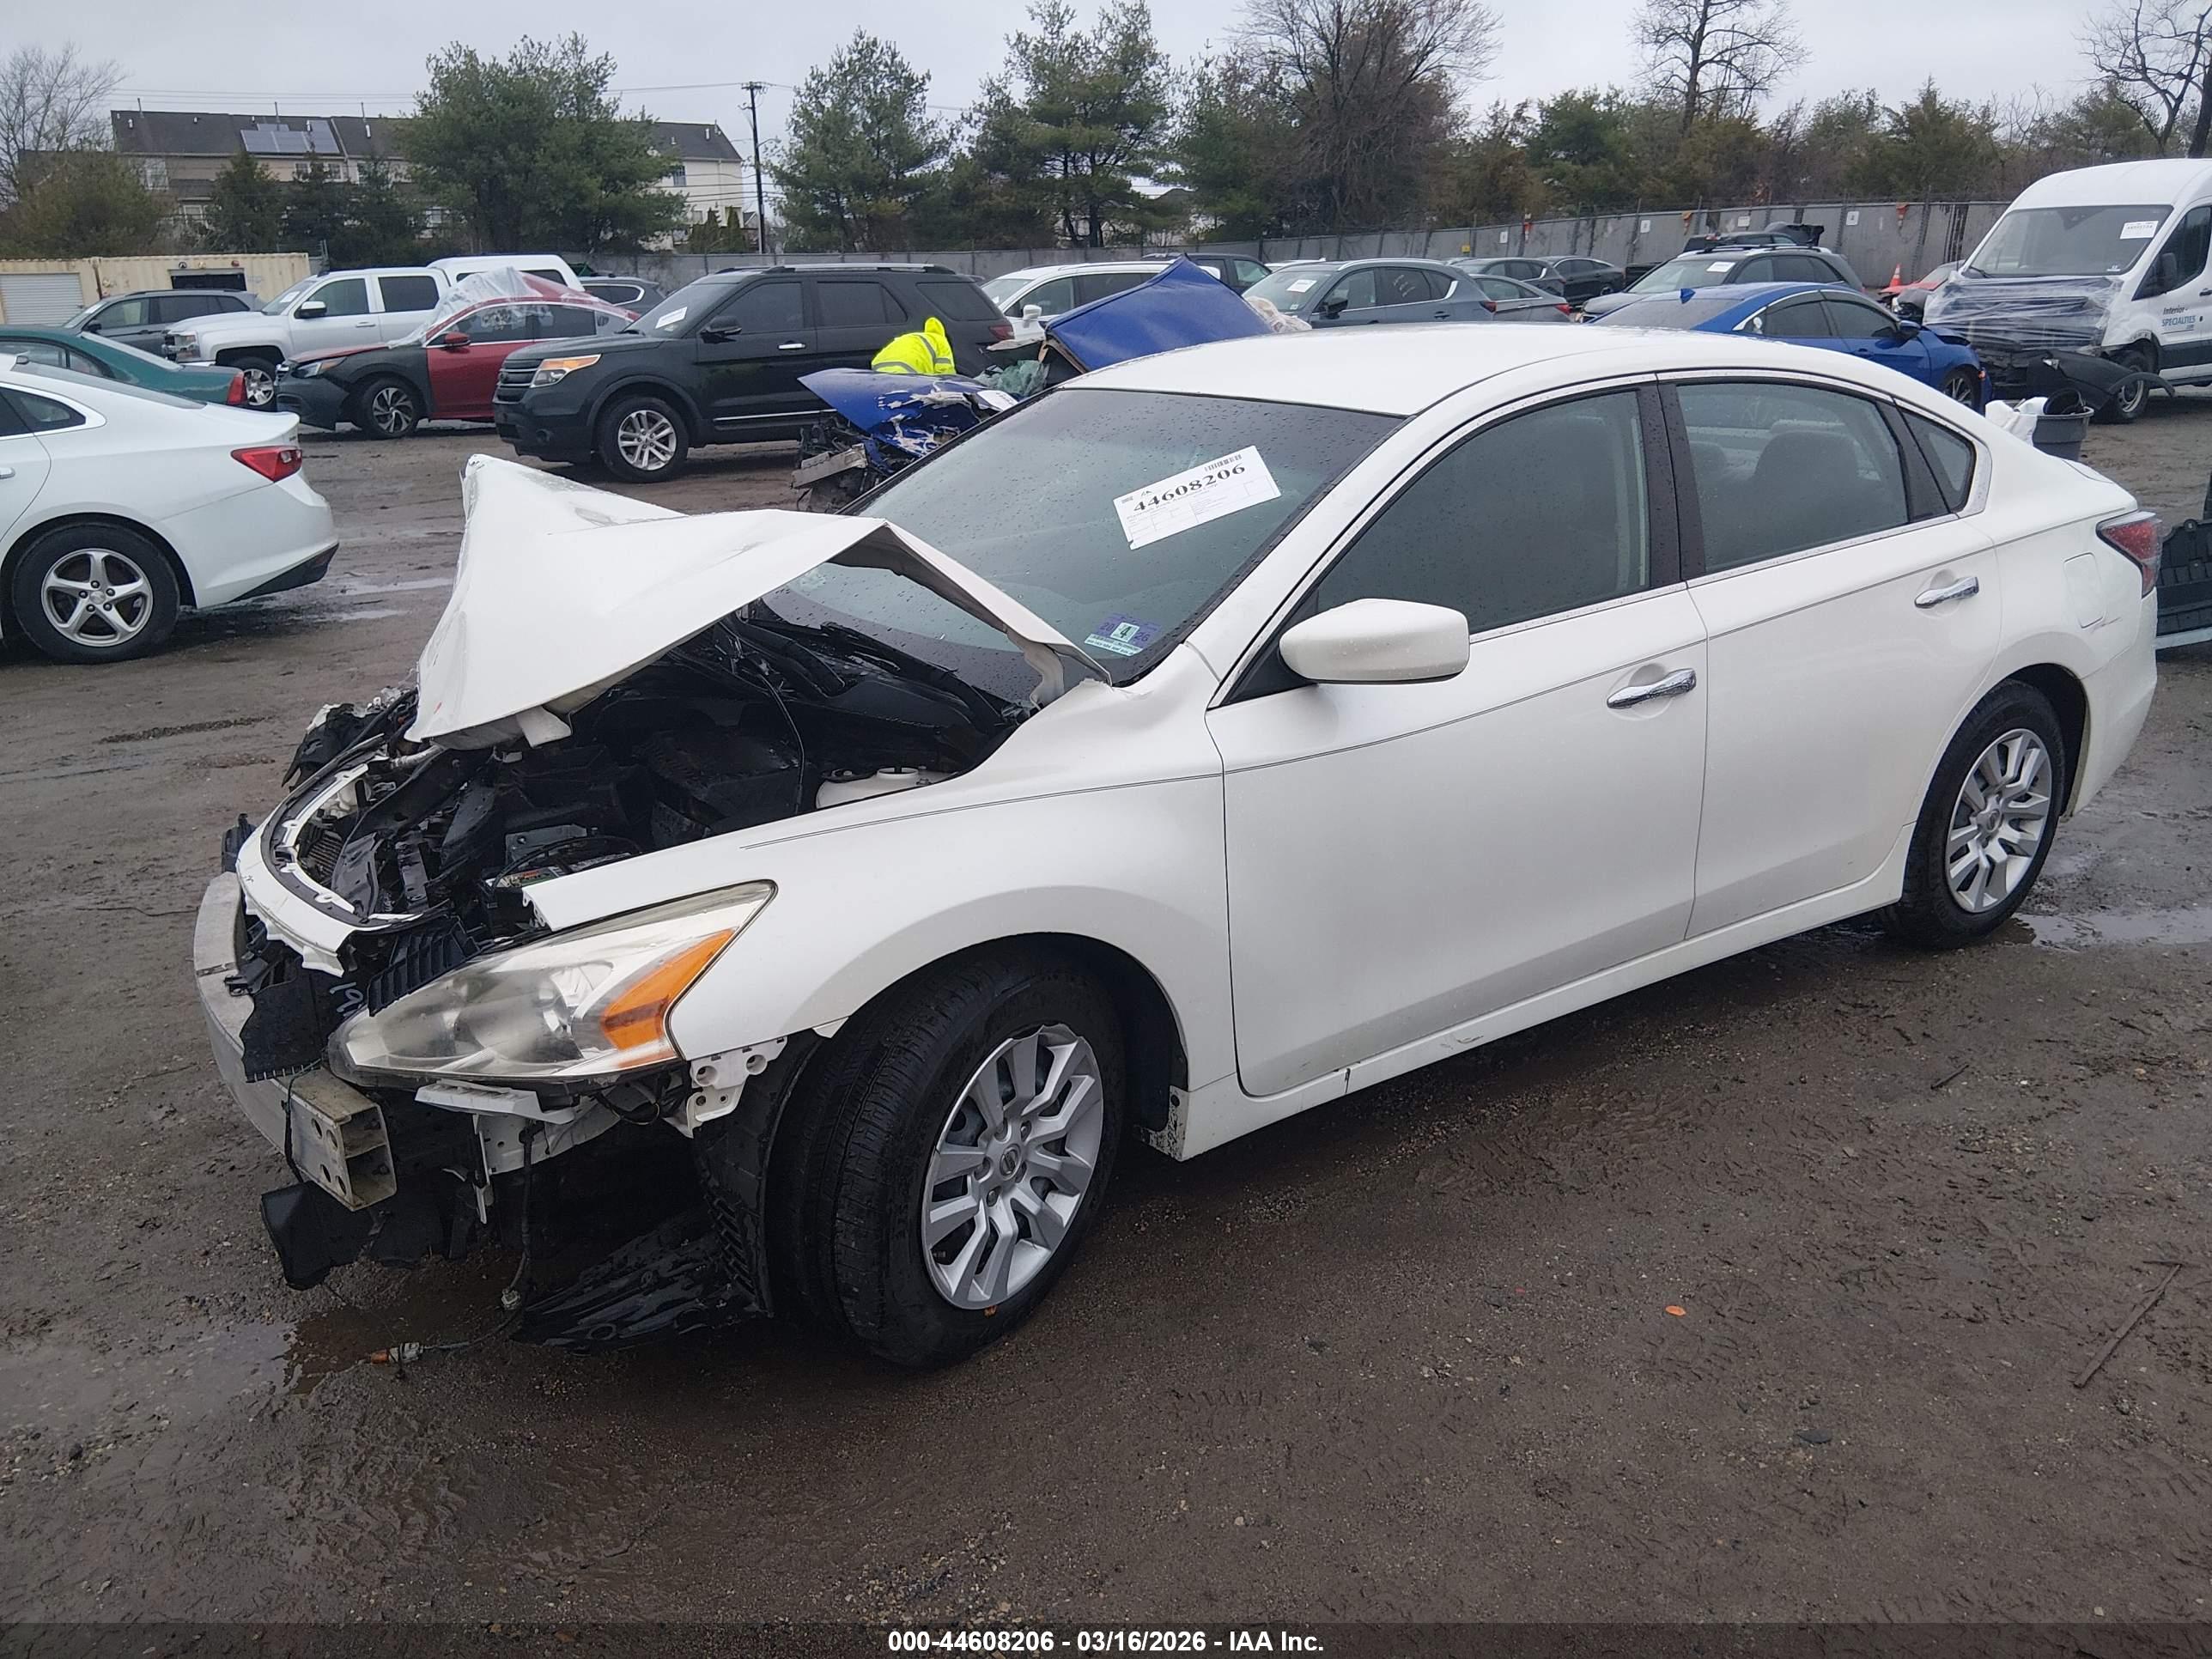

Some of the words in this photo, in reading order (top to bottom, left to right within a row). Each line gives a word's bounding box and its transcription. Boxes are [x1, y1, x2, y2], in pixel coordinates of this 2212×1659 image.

[1133, 463, 1245, 512] 44608206
[1120, 626, 1132, 638] 4
[1134, 631, 1151, 642] 26
